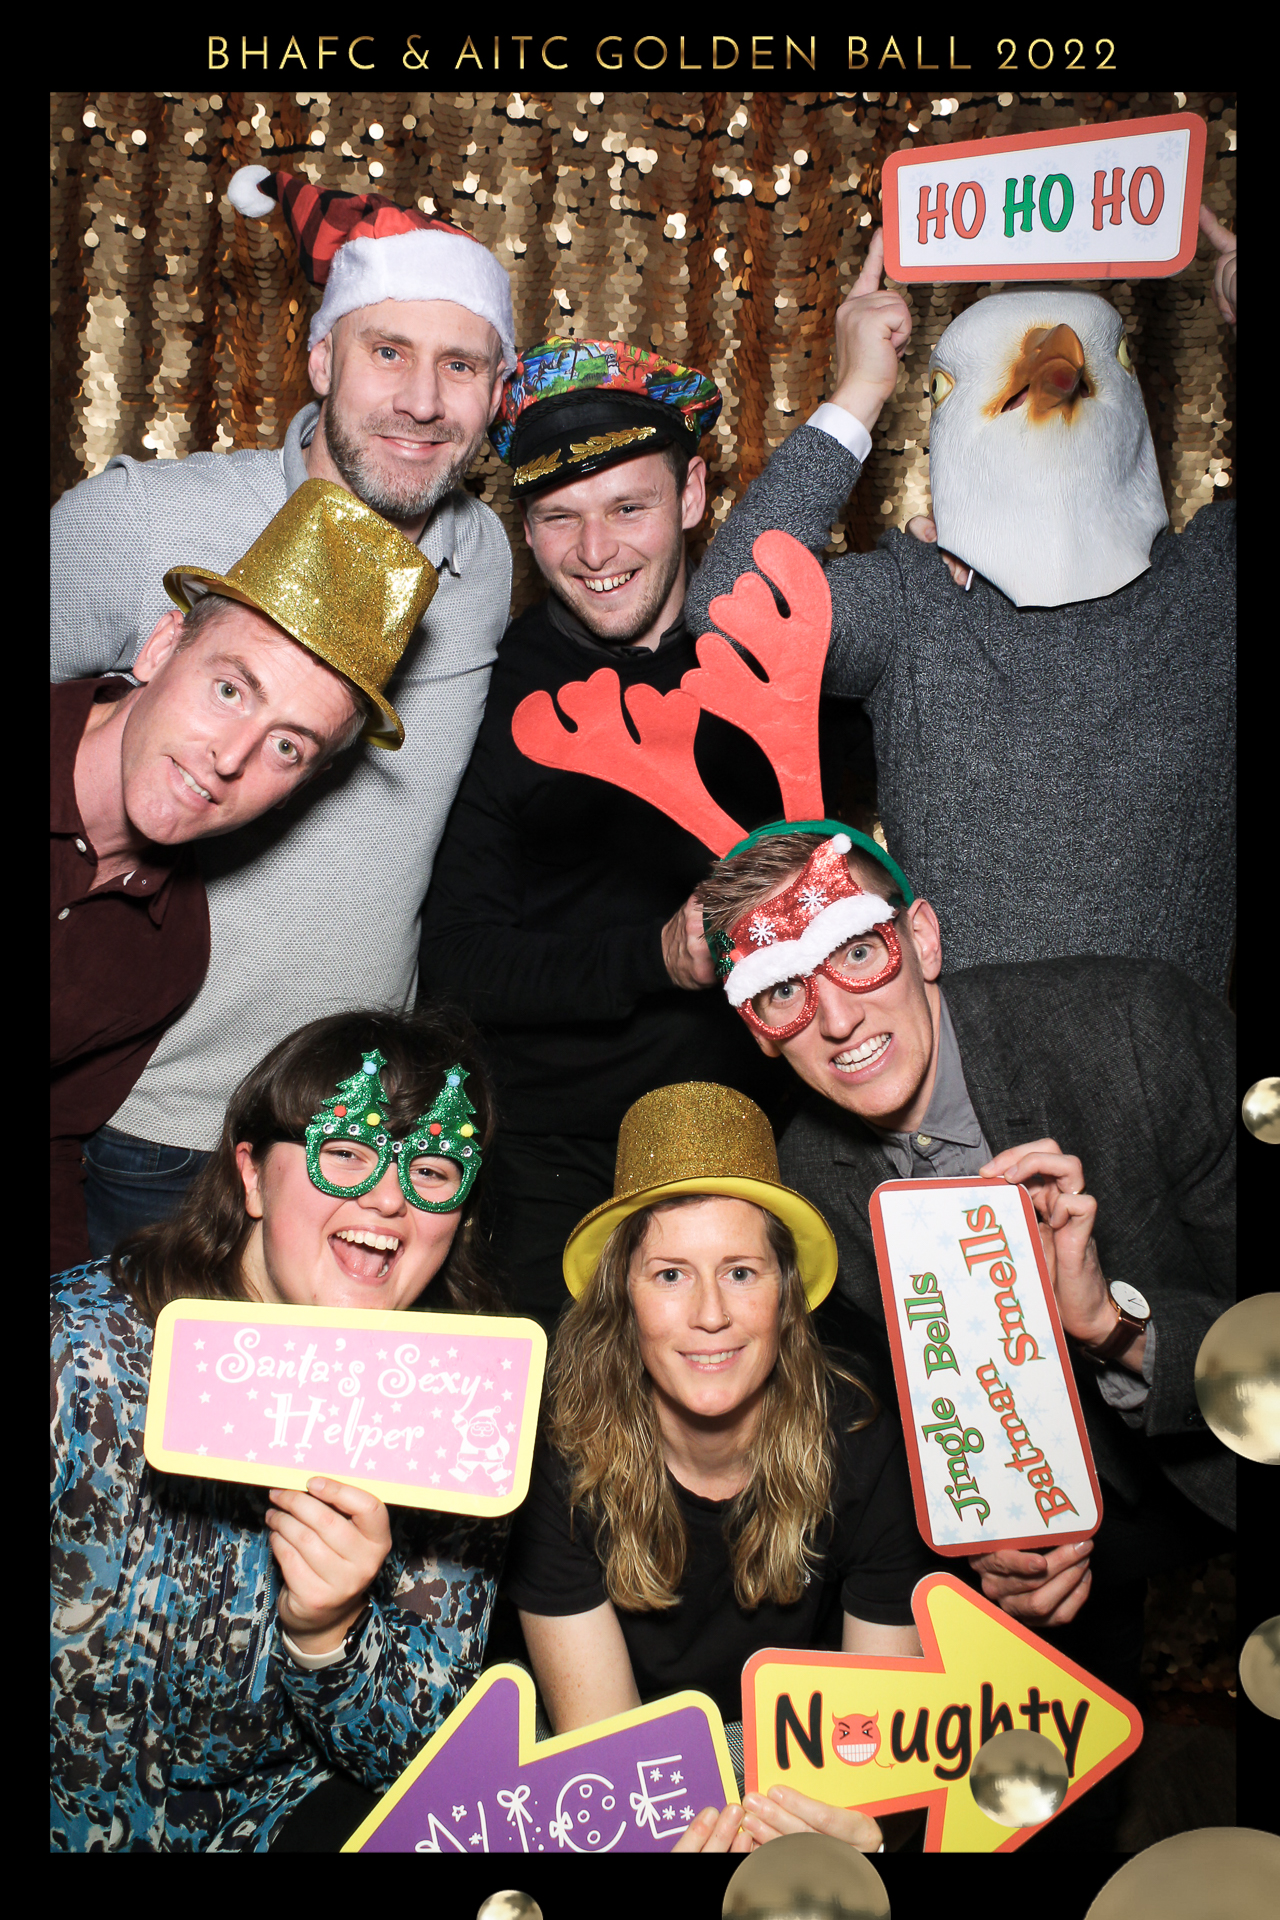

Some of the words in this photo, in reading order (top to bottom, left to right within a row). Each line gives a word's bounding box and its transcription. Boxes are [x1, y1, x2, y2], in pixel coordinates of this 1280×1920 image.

[917, 181, 987, 245] HO
[1003, 173, 1074, 237] HO
[1091, 165, 1165, 231] HO
[904, 1271, 961, 1380] Bells
[958, 1204, 1046, 1366] Smells
[215, 1327, 365, 1398] Santa's
[377, 1343, 482, 1412] Sexy
[264, 1391, 425, 1469] Helper
[921, 1396, 991, 1527] Jingle
[975, 1357, 1080, 1528] Batman
